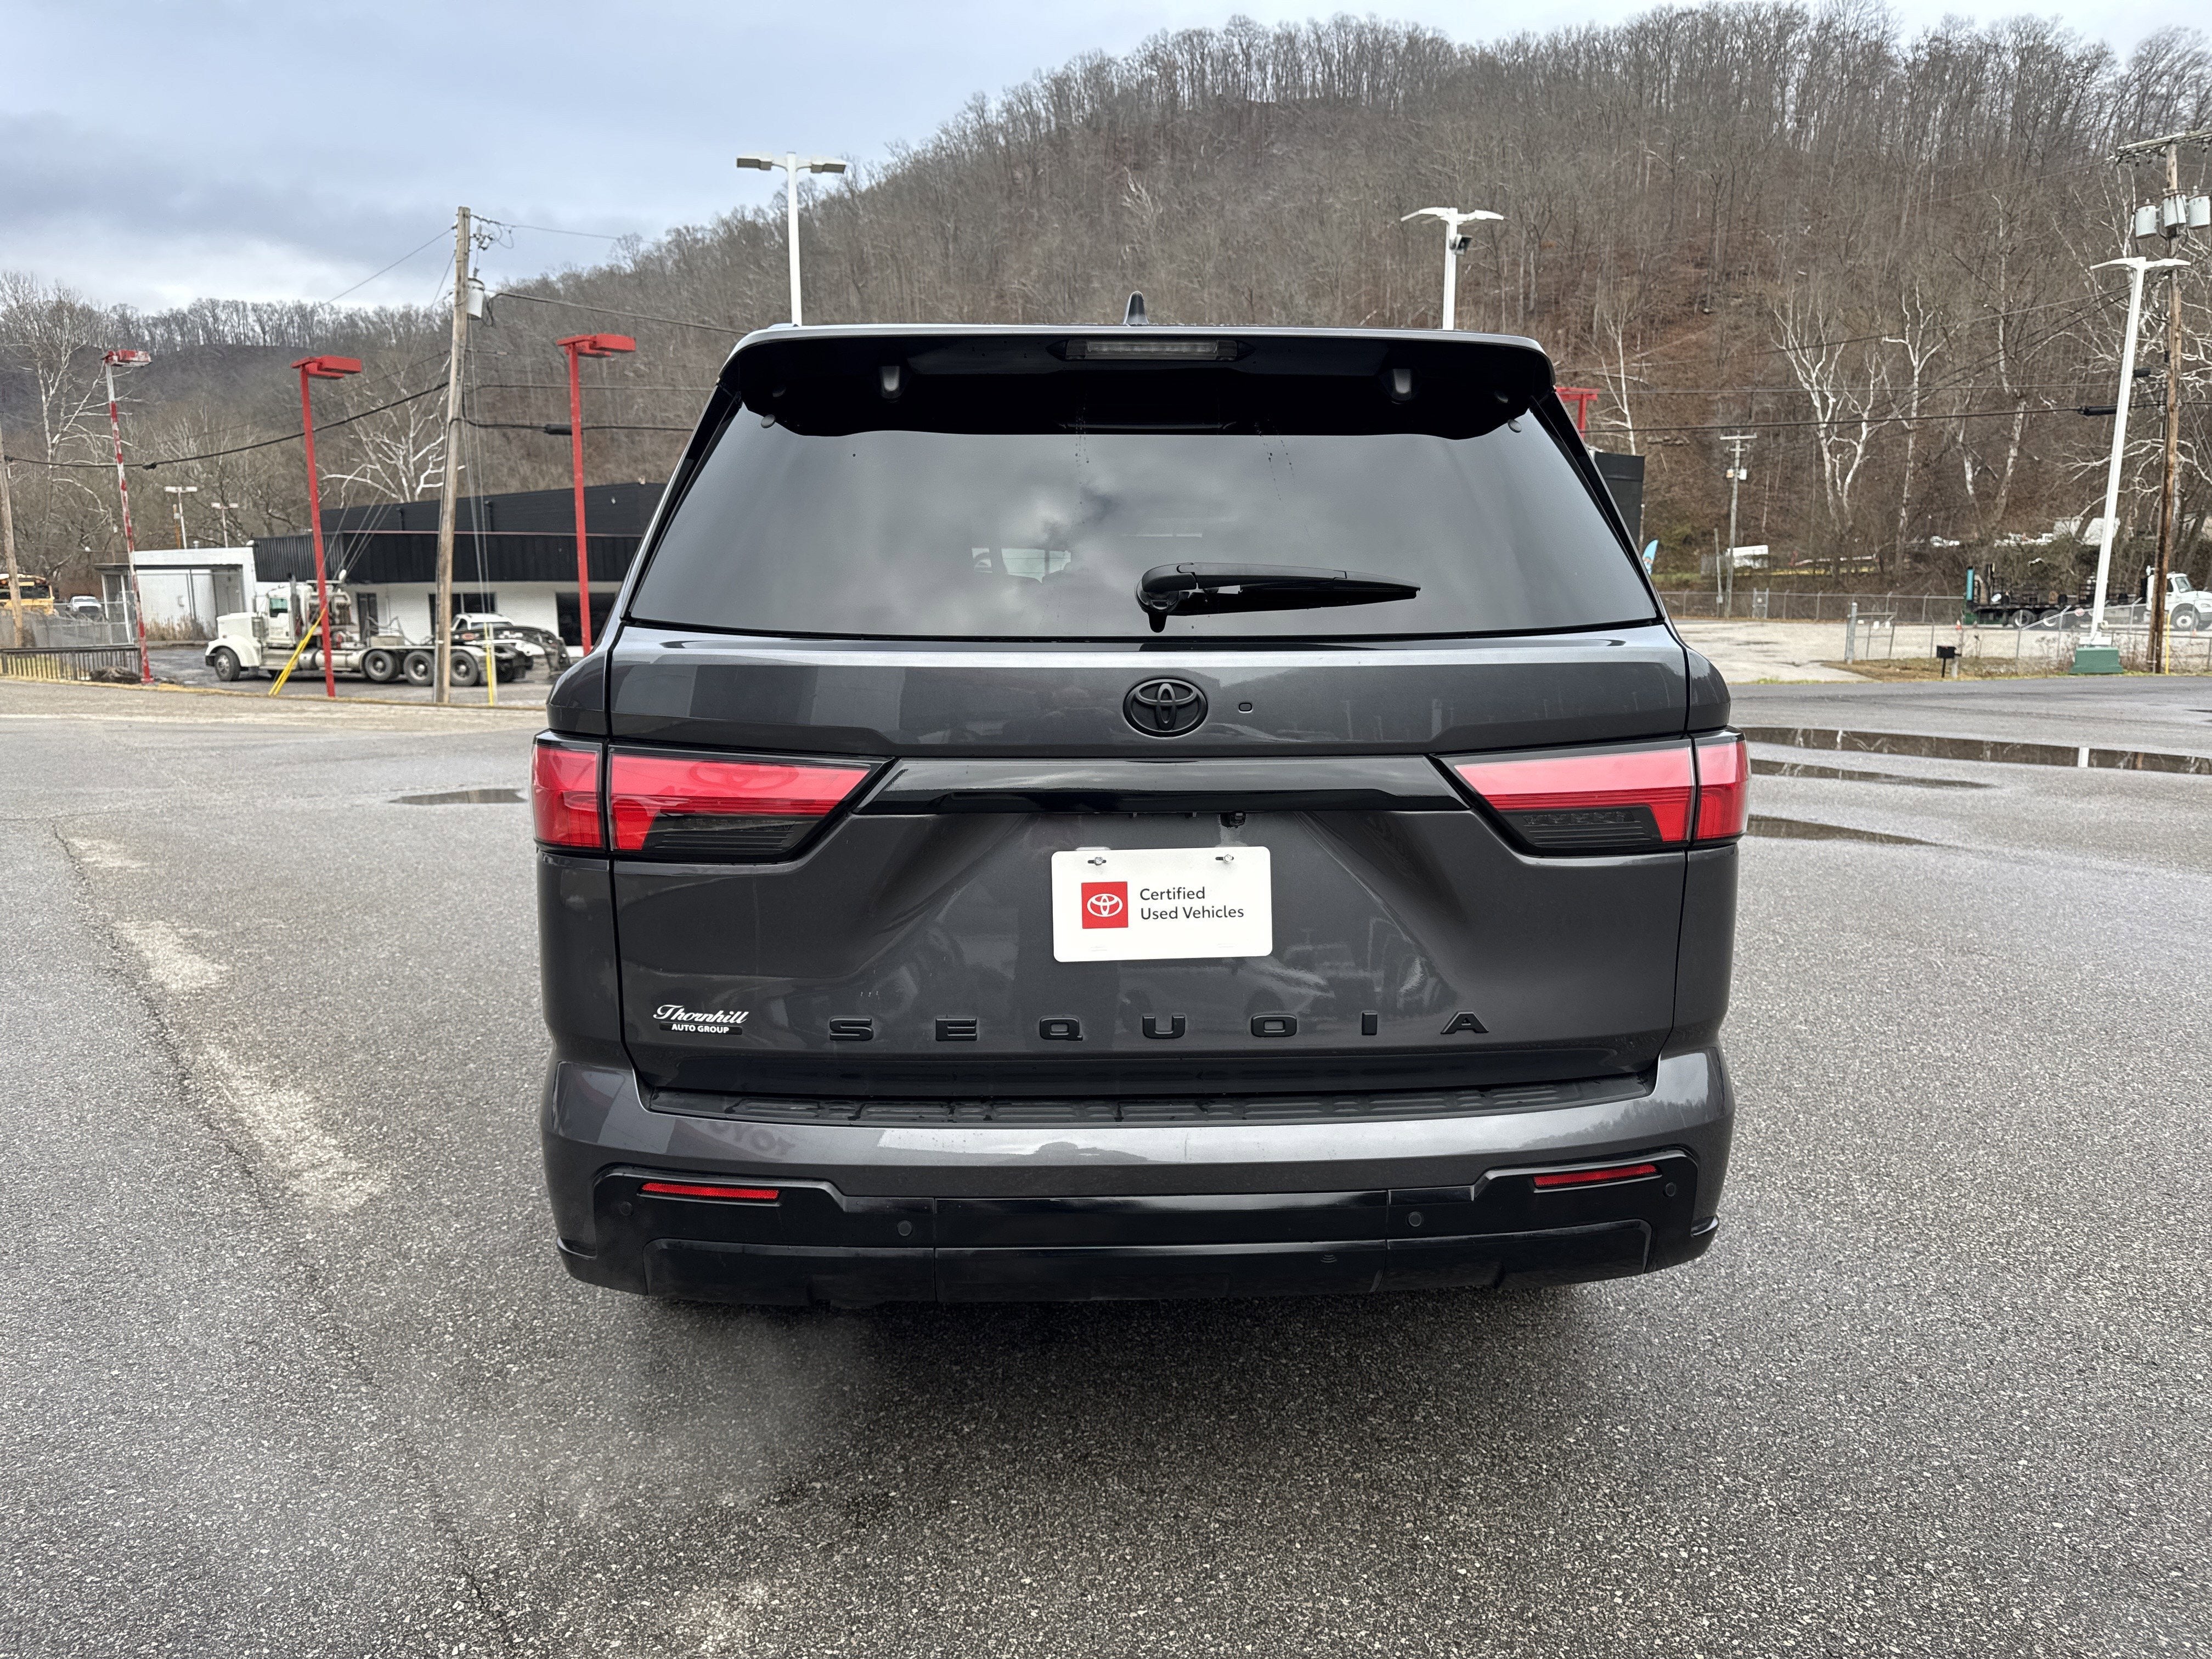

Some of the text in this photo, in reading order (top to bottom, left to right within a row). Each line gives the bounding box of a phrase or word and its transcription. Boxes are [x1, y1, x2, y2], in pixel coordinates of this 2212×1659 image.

[1139, 886, 1205, 901] Certified
[1141, 905, 1244, 920] Used Vehicles
[653, 1005, 749, 1024] Thornhill
[671, 1023, 730, 1034] AUTO GROUP
[829, 1010, 1489, 1042] SEQUOIA
